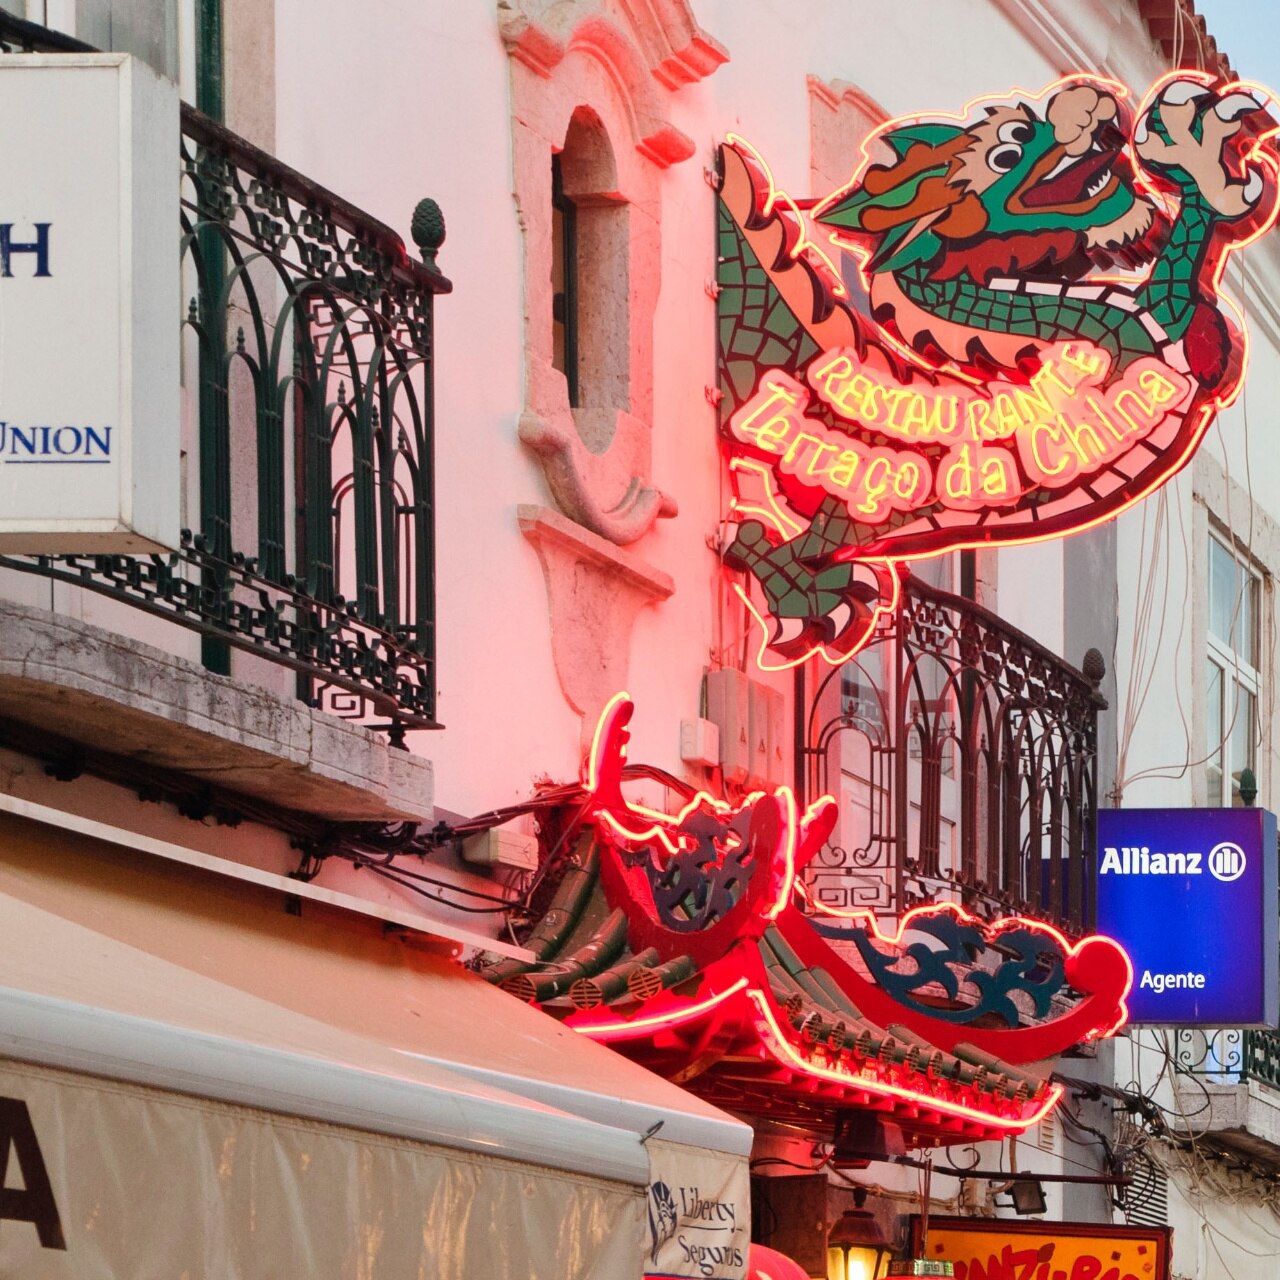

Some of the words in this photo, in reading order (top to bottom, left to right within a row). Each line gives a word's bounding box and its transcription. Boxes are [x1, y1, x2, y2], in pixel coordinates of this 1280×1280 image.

[814, 343, 1104, 440] RESTAURANTE
[0, 422, 112, 455] NION
[740, 379, 920, 516] Terraço
[945, 442, 1009, 499] da
[1030, 366, 1182, 476] China
[1100, 847, 1202, 875] Allianz
[1140, 970, 1206, 993] Agente
[679, 1187, 735, 1233] Liberty
[677, 1235, 744, 1276] Seguros
